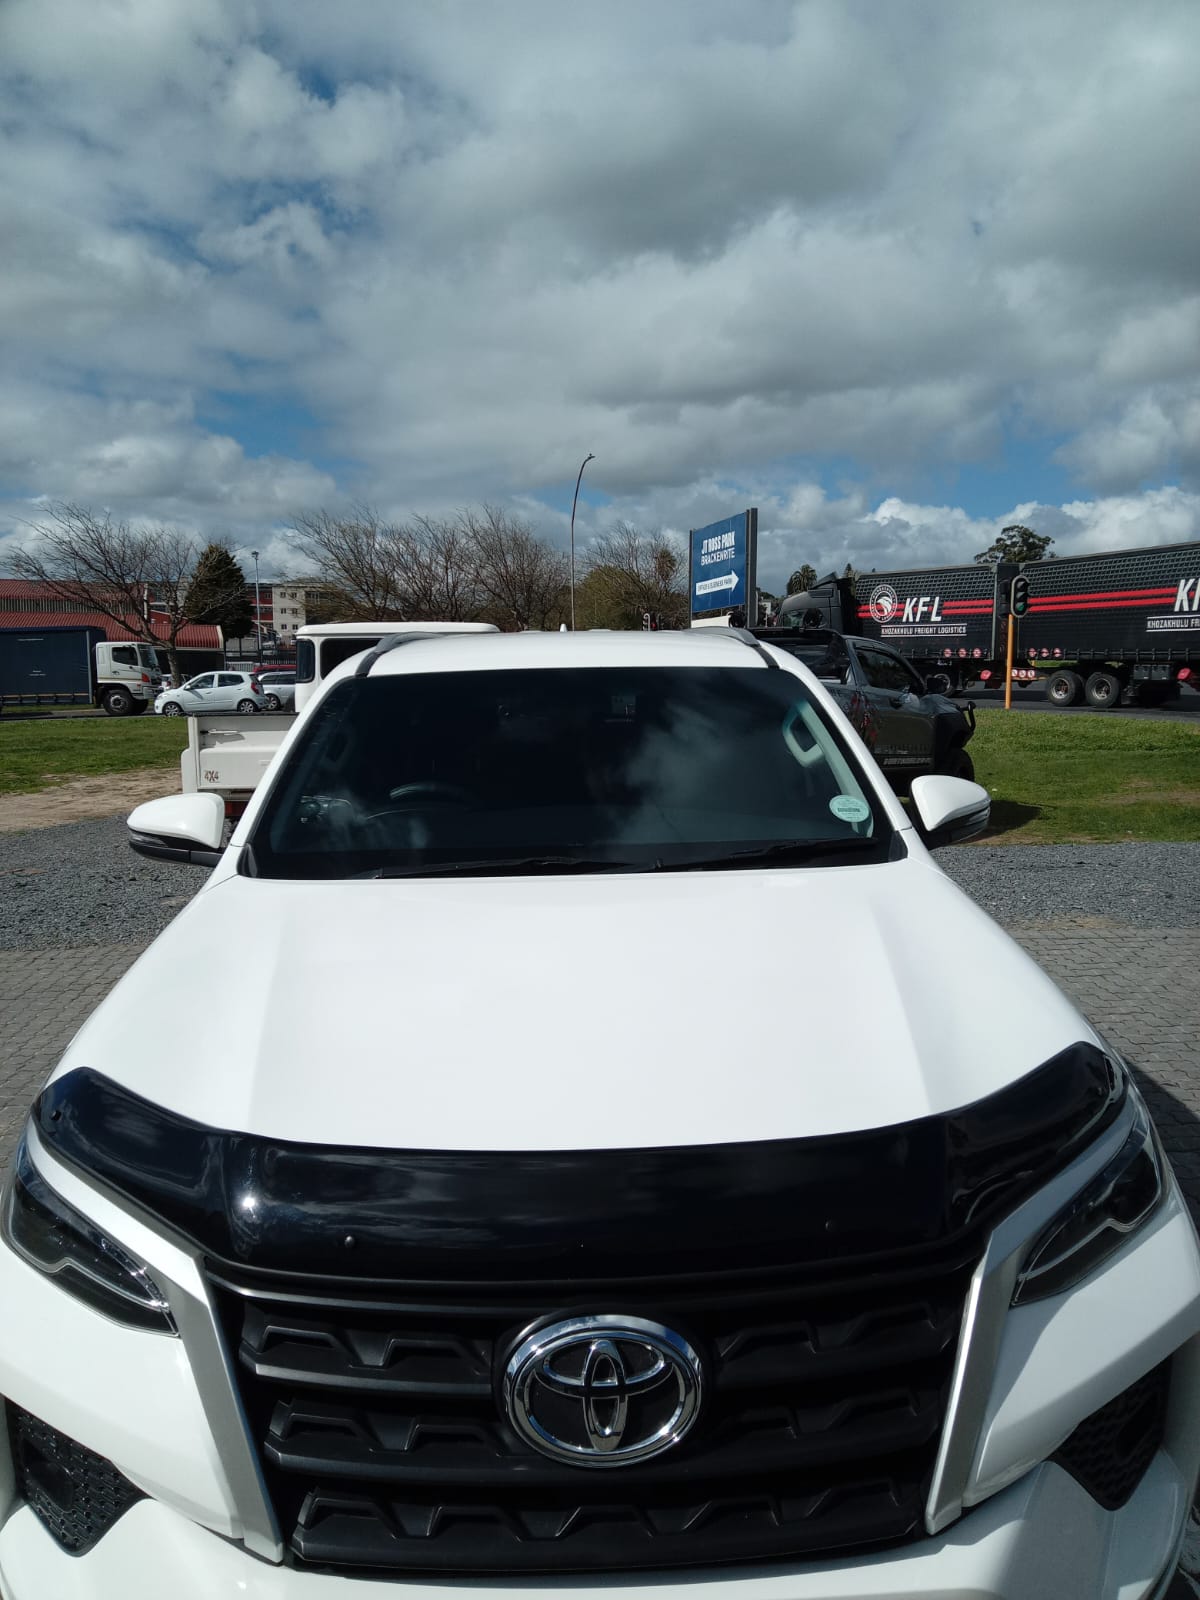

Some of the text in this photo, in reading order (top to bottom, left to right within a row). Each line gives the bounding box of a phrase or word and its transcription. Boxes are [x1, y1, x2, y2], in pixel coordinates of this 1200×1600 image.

[902, 596, 942, 623] KFL
[1147, 619, 1189, 629] KHOZAKHULU
[938, 626, 967, 634] LOGISTICS
